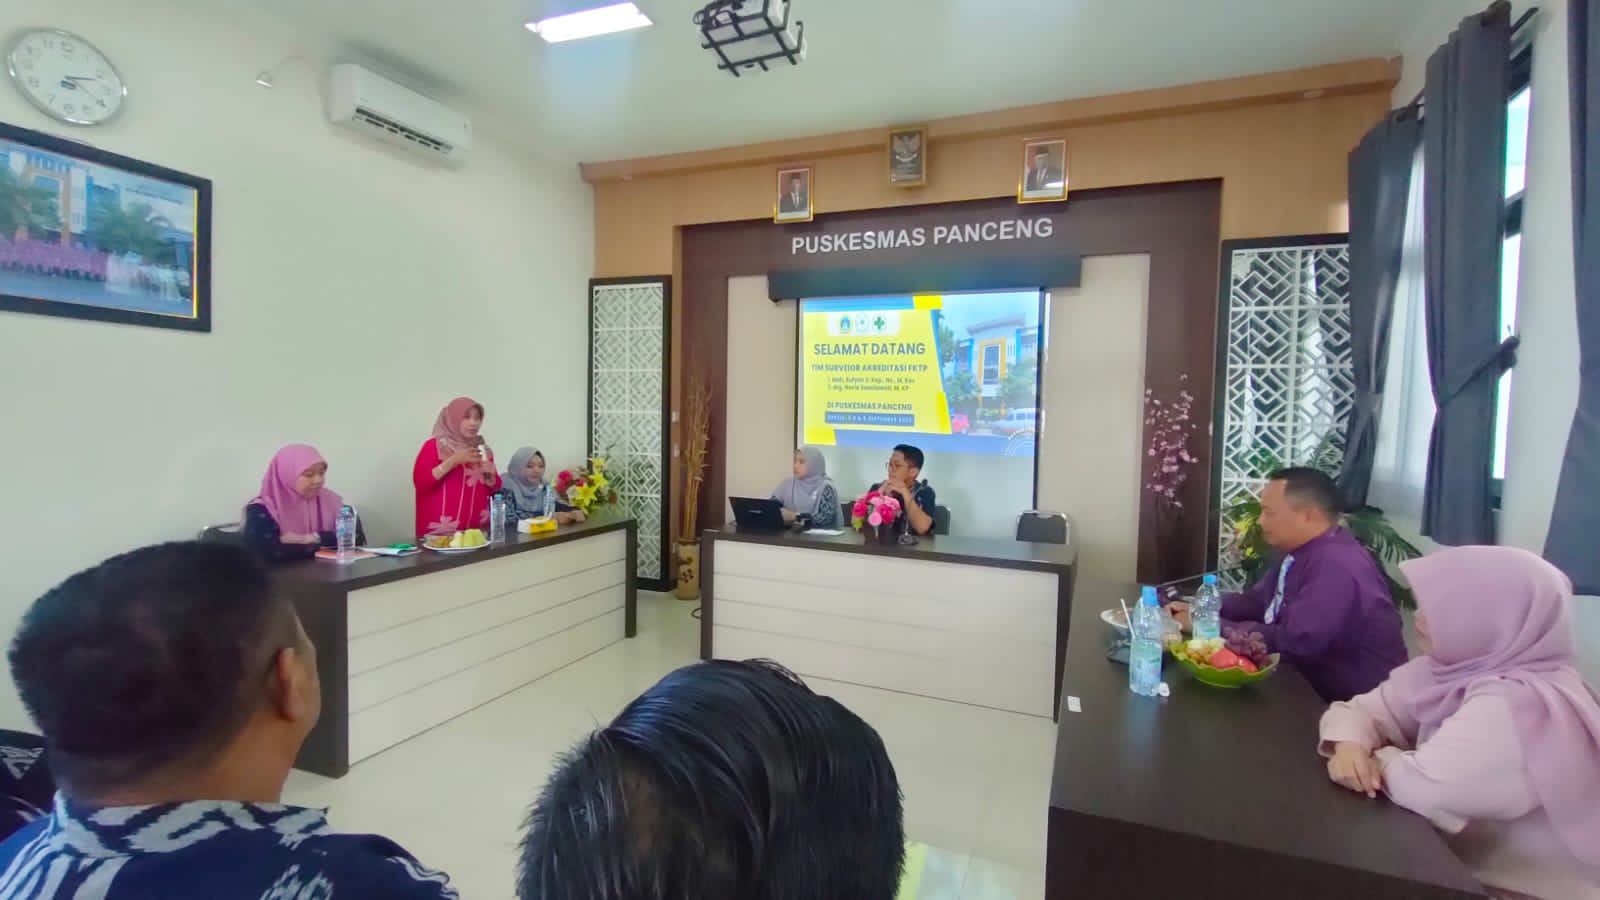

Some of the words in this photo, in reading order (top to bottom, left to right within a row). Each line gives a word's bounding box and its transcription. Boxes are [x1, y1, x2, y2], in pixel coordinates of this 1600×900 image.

[792, 230, 926, 254] PUSKESMAS
[933, 217, 1053, 245] PANCENG
[813, 342, 868, 355] SELAMAT
[871, 342, 926, 355] DATANG
[862, 363, 907, 372] AKREDITASI
[835, 402, 876, 410] PUSKESMAS
[878, 403, 912, 411] PANCENG
